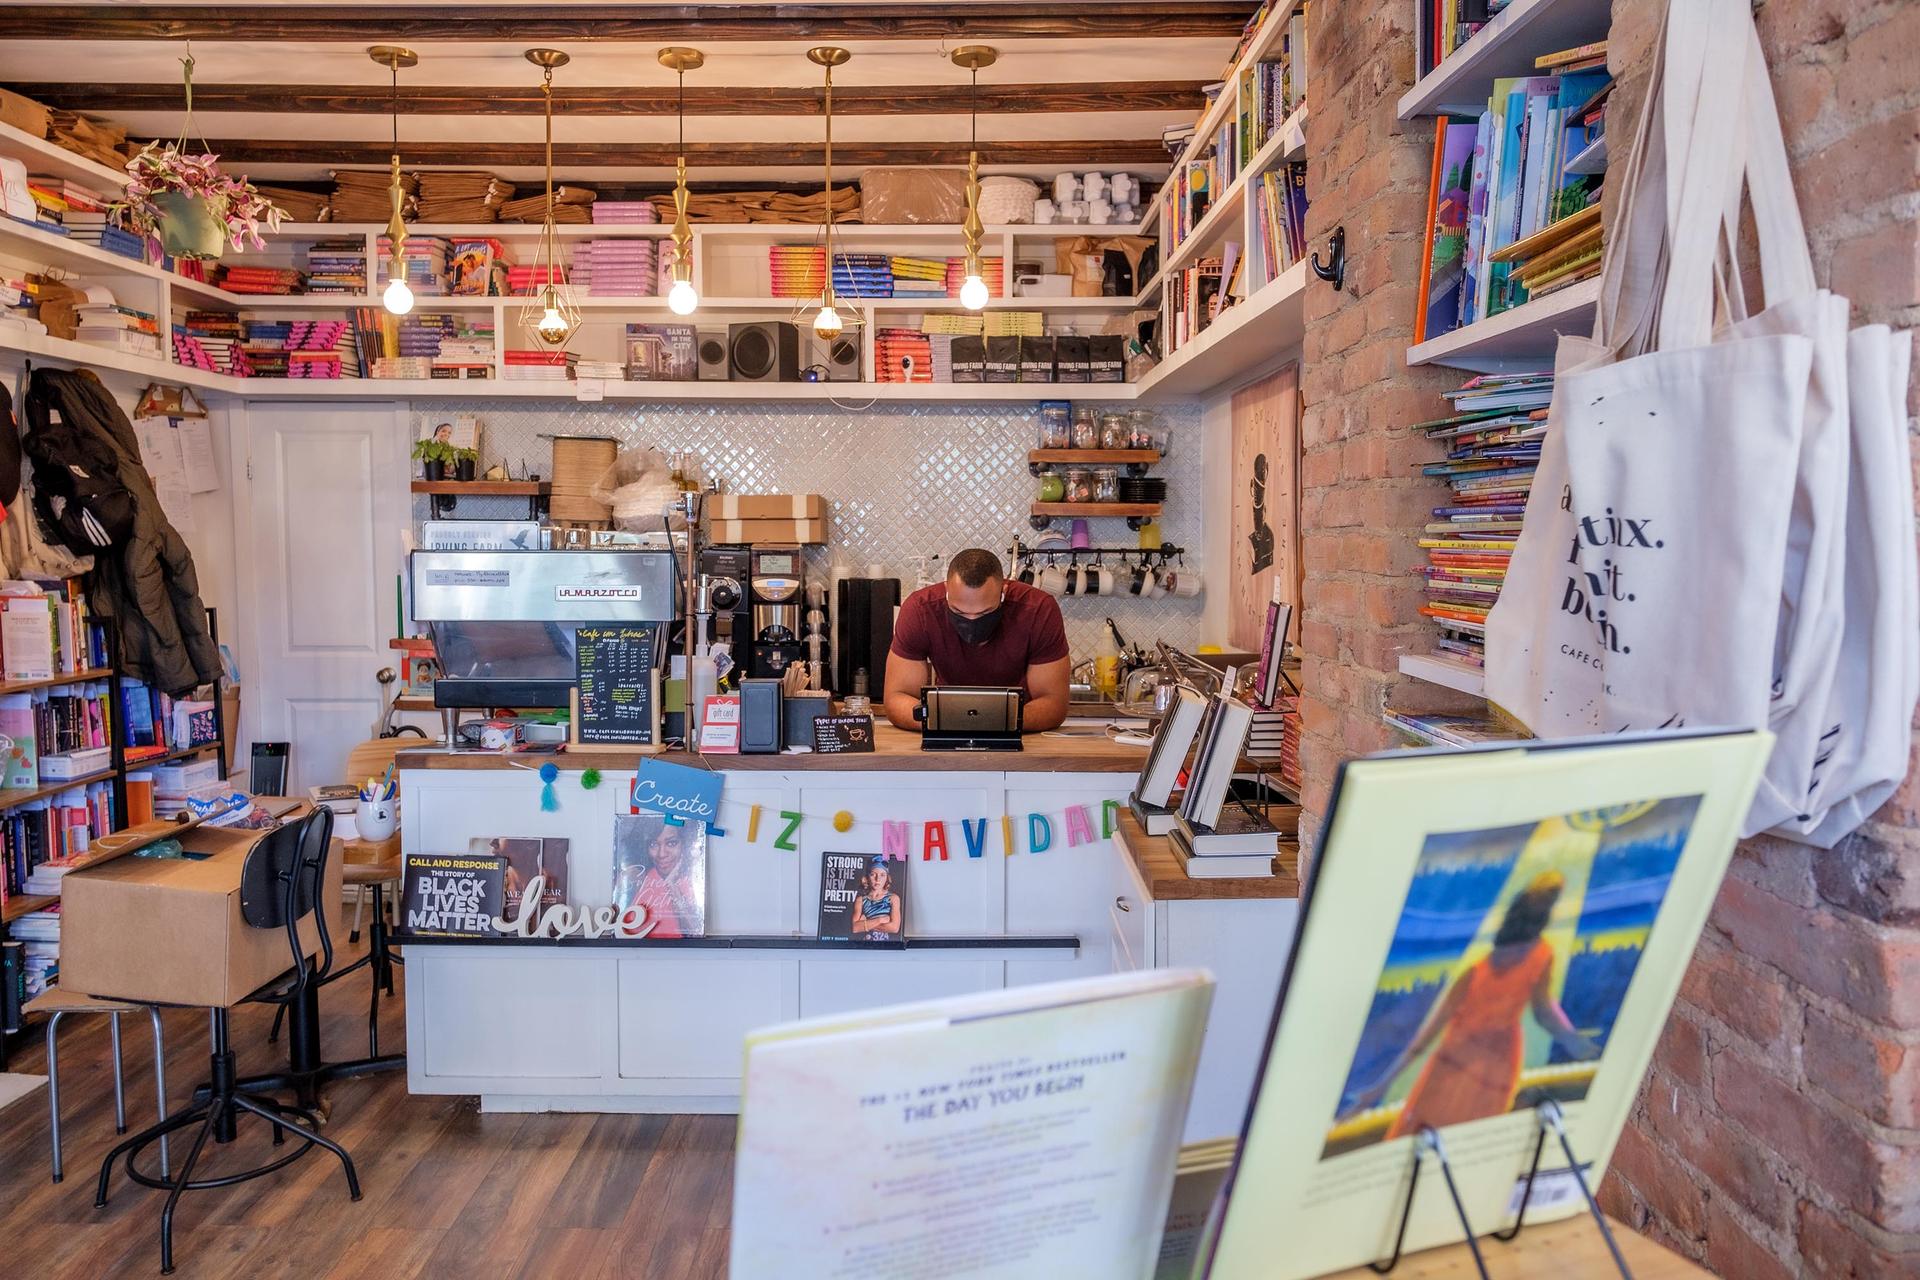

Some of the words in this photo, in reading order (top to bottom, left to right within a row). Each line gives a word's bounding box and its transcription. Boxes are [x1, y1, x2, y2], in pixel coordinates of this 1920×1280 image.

[1560, 644, 1590, 664] CAFE
[634, 780, 713, 816] Create
[409, 858, 433, 868] CALL
[433, 859, 452, 868] AND
[453, 860, 499, 870] RESPONSE
[827, 856, 863, 869] STRONG
[466, 871, 475, 879] OF
[826, 868, 836, 879] IS
[838, 868, 855, 880] THE
[418, 876, 487, 898] BLACK
[825, 879, 846, 890] NEW
[422, 894, 480, 914] LIVES
[824, 890, 858, 902] PRETTY
[491, 875, 660, 940] love
[407, 910, 491, 932] MATTER
[902, 1103, 937, 1124] THE
[943, 1094, 983, 1116] DAY
[987, 1084, 1030, 1107] YOU
[1034, 1074, 1085, 1098] BEGIN
